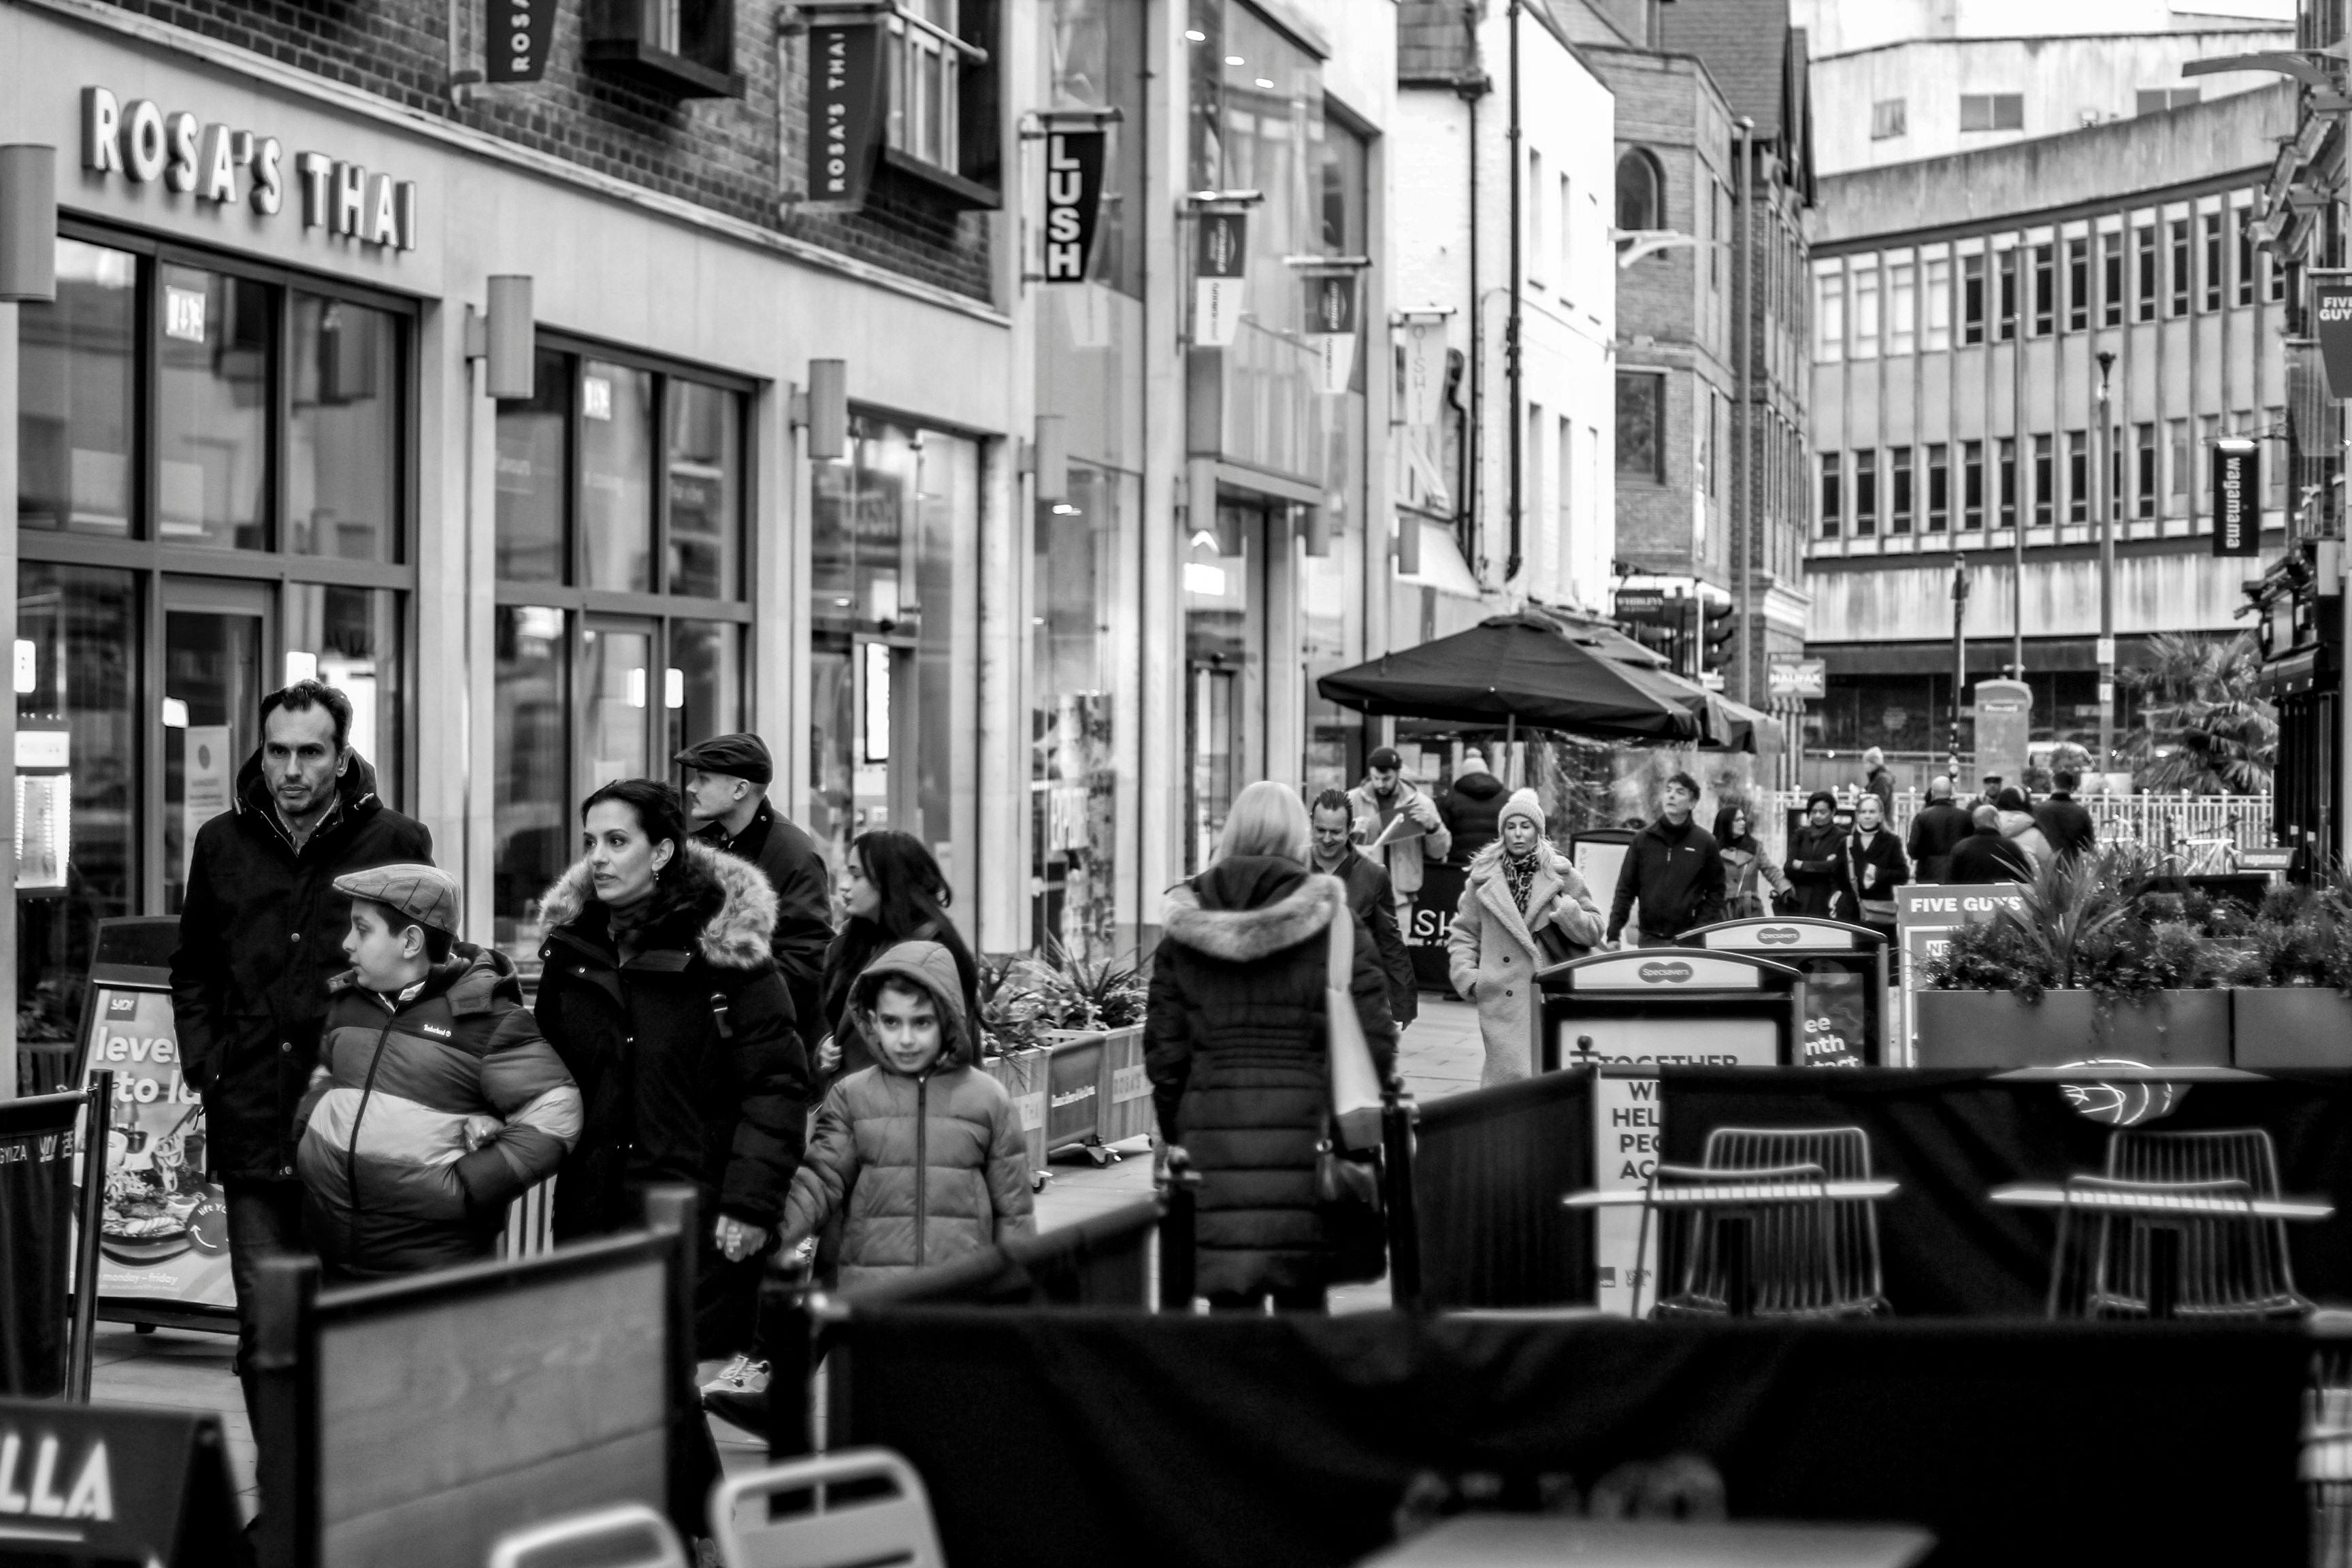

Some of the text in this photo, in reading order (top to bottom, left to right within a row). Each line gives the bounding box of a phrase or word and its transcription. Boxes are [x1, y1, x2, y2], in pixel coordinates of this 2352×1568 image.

[827, 33, 846, 193] ROSA'S THAI
[80, 86, 416, 250] ROSA'S THAI
[1049, 135, 1082, 278] LUSH
[1413, 324, 1426, 423] OISHII
[2223, 457, 2241, 549] wagamama
[1910, 898, 1957, 913] FIVE
[1642, 968, 1689, 977] Specsavers
[110, 1001, 134, 1011] YO!
[423, 1024, 446, 1036] Timberland
[116, 1071, 159, 1103] to
[103, 1273, 140, 1284] monday
[148, 1273, 178, 1286] friday
